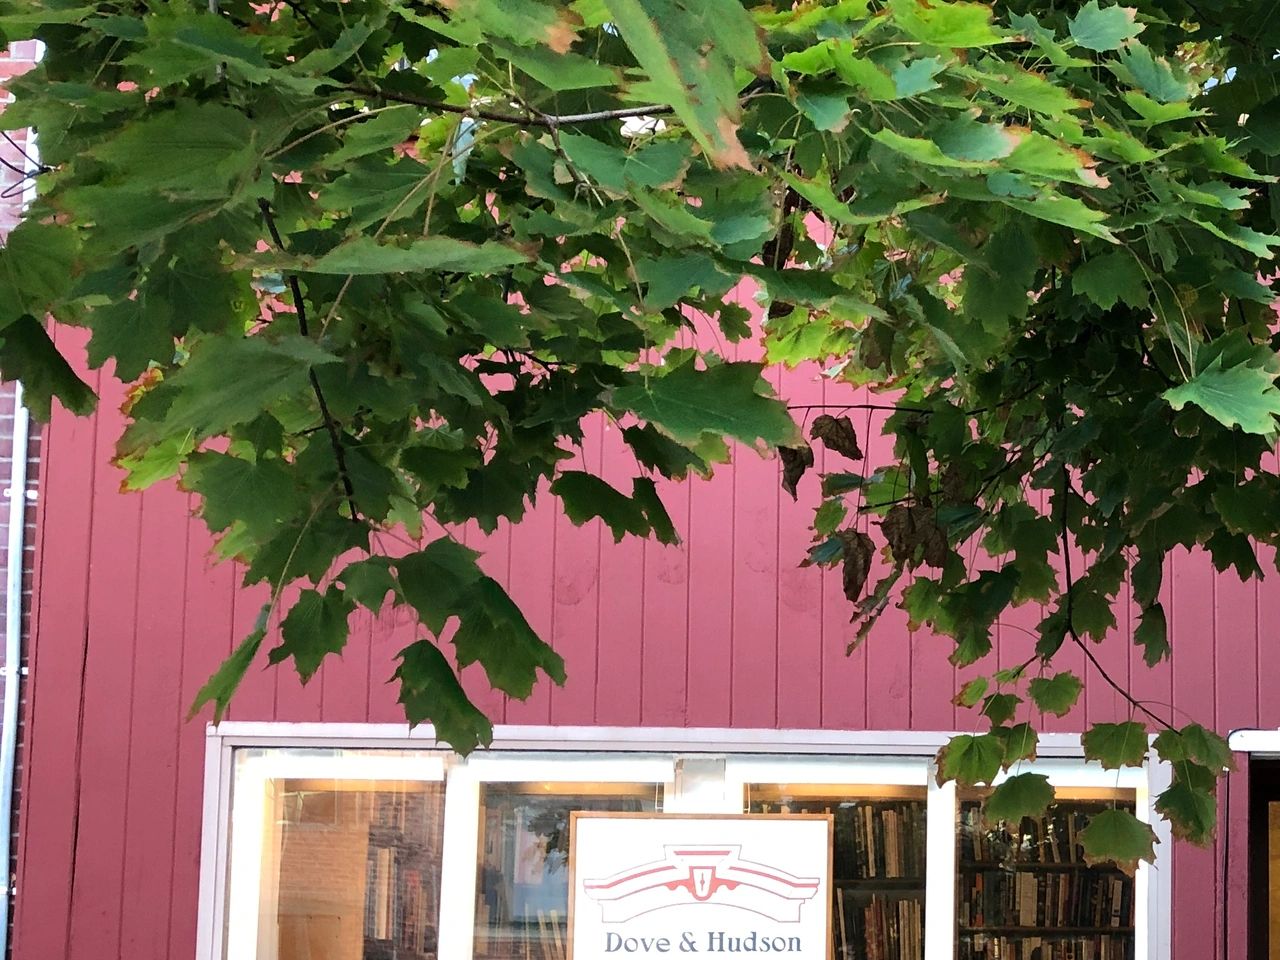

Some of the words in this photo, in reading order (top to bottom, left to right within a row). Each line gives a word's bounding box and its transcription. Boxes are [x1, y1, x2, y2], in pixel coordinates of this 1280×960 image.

[605, 931, 671, 953] Dove
[679, 931, 699, 953] &
[707, 931, 802, 953] Hudson
